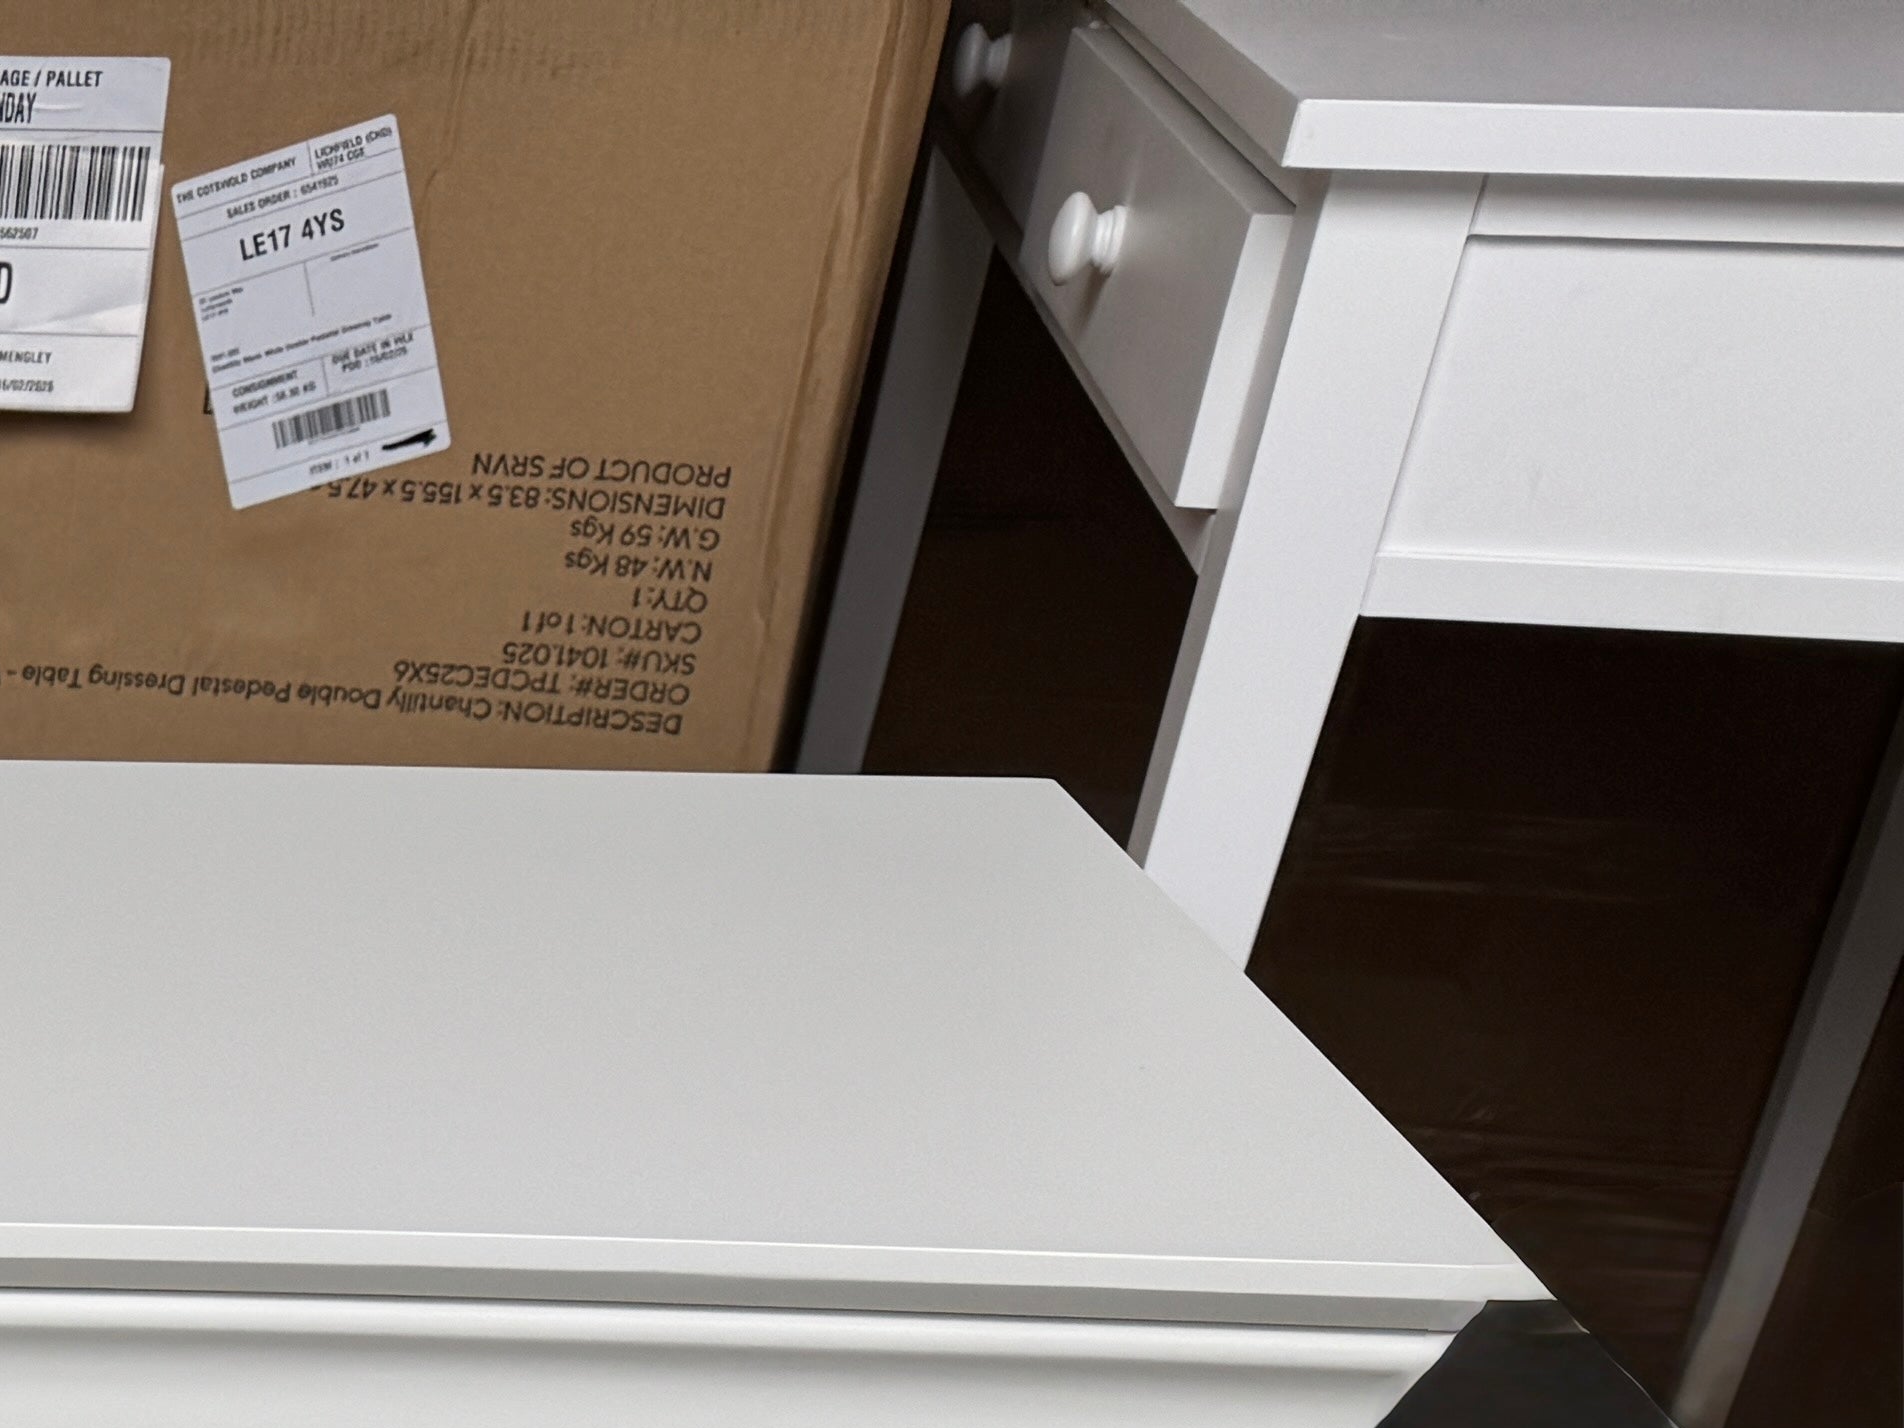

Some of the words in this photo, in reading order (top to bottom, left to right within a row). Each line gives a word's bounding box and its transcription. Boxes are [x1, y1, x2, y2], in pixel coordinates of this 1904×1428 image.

[33, 69, 42, 88] /
[45, 69, 103, 87] PALLET
[257, 189, 291, 209] ORDER
[239, 223, 291, 261] LE17
[301, 207, 345, 240] 4YS
[471, 451, 545, 478] SRVN
[547, 455, 590, 480] OF
[592, 457, 731, 489] PRODUCT
[399, 478, 462, 504] 155.5
[486, 483, 541, 509] 83.5
[543, 487, 726, 520] DIMENSIONS:
[569, 514, 615, 544] Kgs
[618, 522, 653, 546] 59
[657, 524, 720, 550] G.W:
[563, 545, 609, 575] Kgs
[613, 553, 648, 577] 48
[651, 555, 712, 582] N.W:
[631, 585, 641, 606] 1
[646, 586, 708, 612] QTY:
[520, 610, 530, 631] 1
[534, 610, 562, 632] of
[564, 612, 574, 634] 1
[580, 613, 702, 644] CARTON:
[501, 640, 608, 668] 1041.025
[616, 645, 696, 674] SKU#:
[21, 664, 82, 689] Table
[86, 662, 186, 696] Dressing
[190, 675, 292, 703] Pedestal
[392, 658, 560, 693] TPCDEC25X6
[568, 673, 690, 704] ORDER#:
[296, 683, 382, 710] Double
[384, 684, 492, 719] Chantilly
[495, 699, 683, 735] DESCRIPTION:
